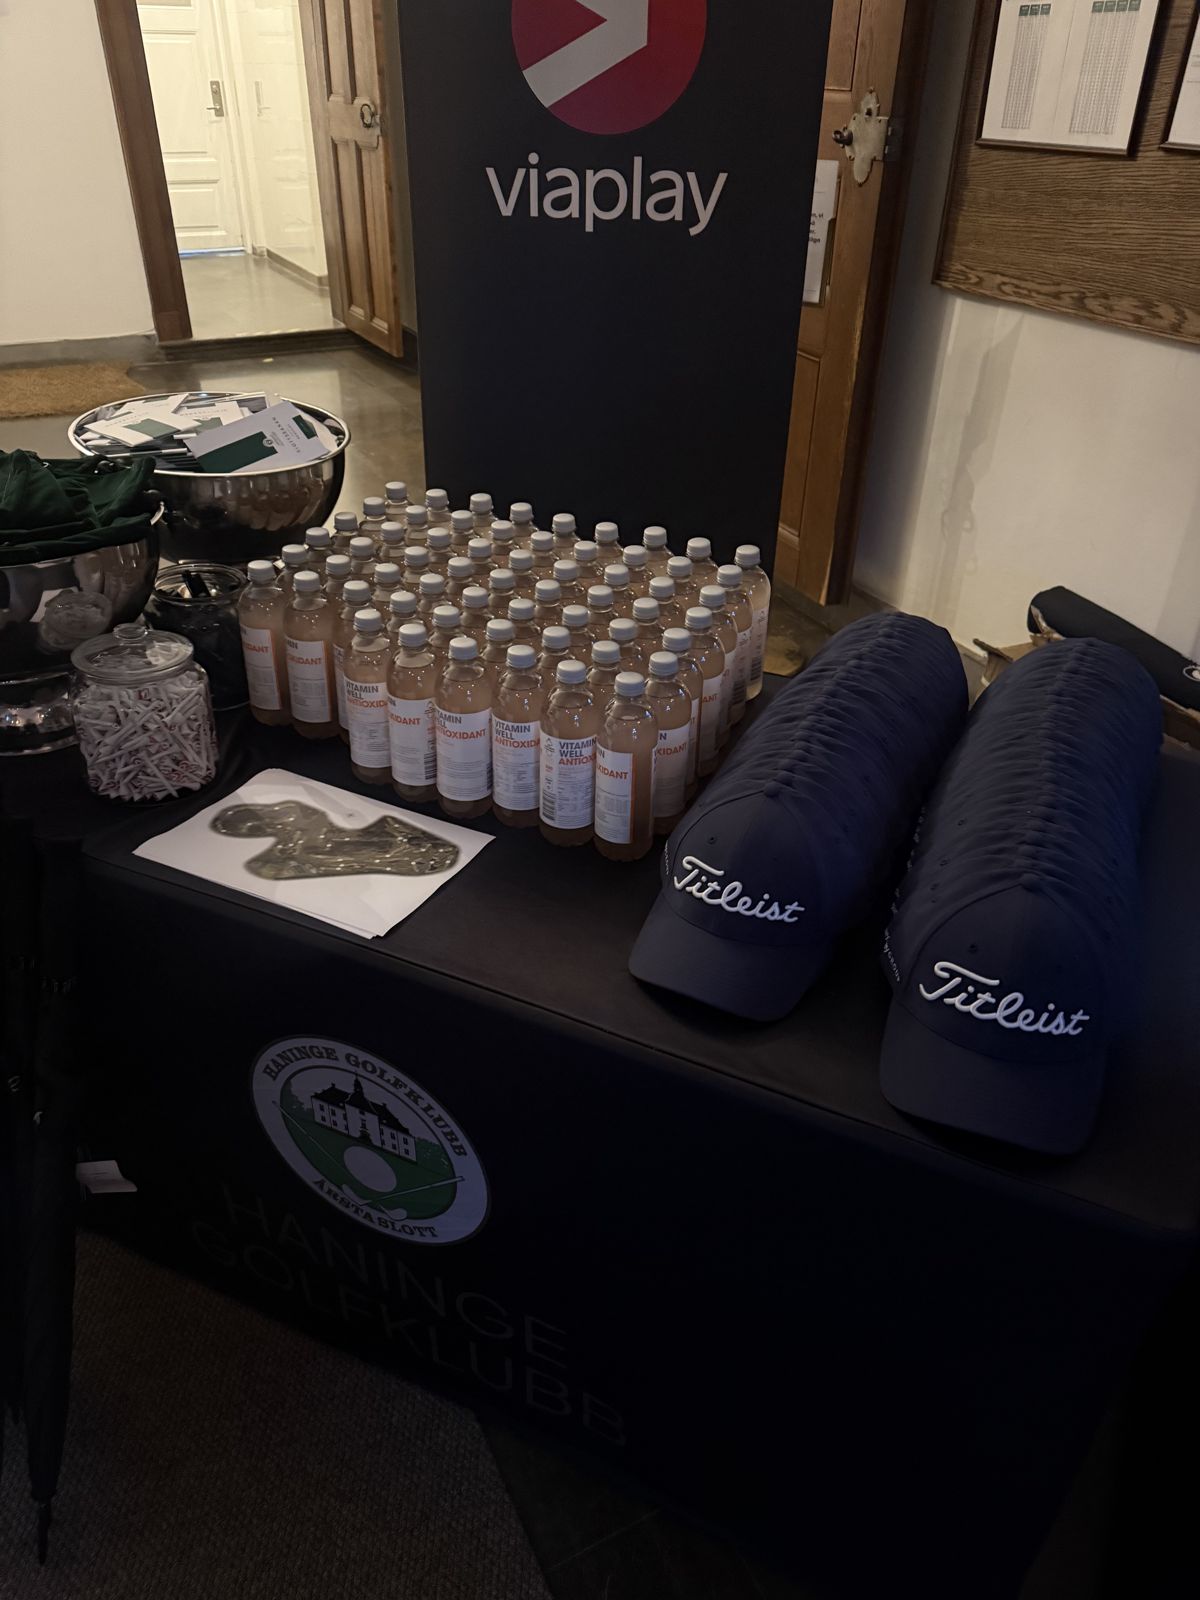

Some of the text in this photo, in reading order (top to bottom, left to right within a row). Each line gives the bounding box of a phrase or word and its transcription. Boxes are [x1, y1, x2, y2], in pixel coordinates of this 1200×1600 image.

[485, 152, 729, 237] viaplay
[494, 719, 531, 734] VITAMIN
[494, 728, 515, 740] WELL
[558, 739, 597, 751] VITAMIN
[559, 749, 584, 759] WELL
[673, 855, 806, 923] Titleist
[919, 960, 1091, 1036] Titleist
[262, 1044, 468, 1158] HANINGE GOLFKLUBB
[376, 1216, 438, 1238] SLOTT
[221, 1182, 569, 1368] HANINGE
[191, 1220, 628, 1448] GOLFKLUBB
